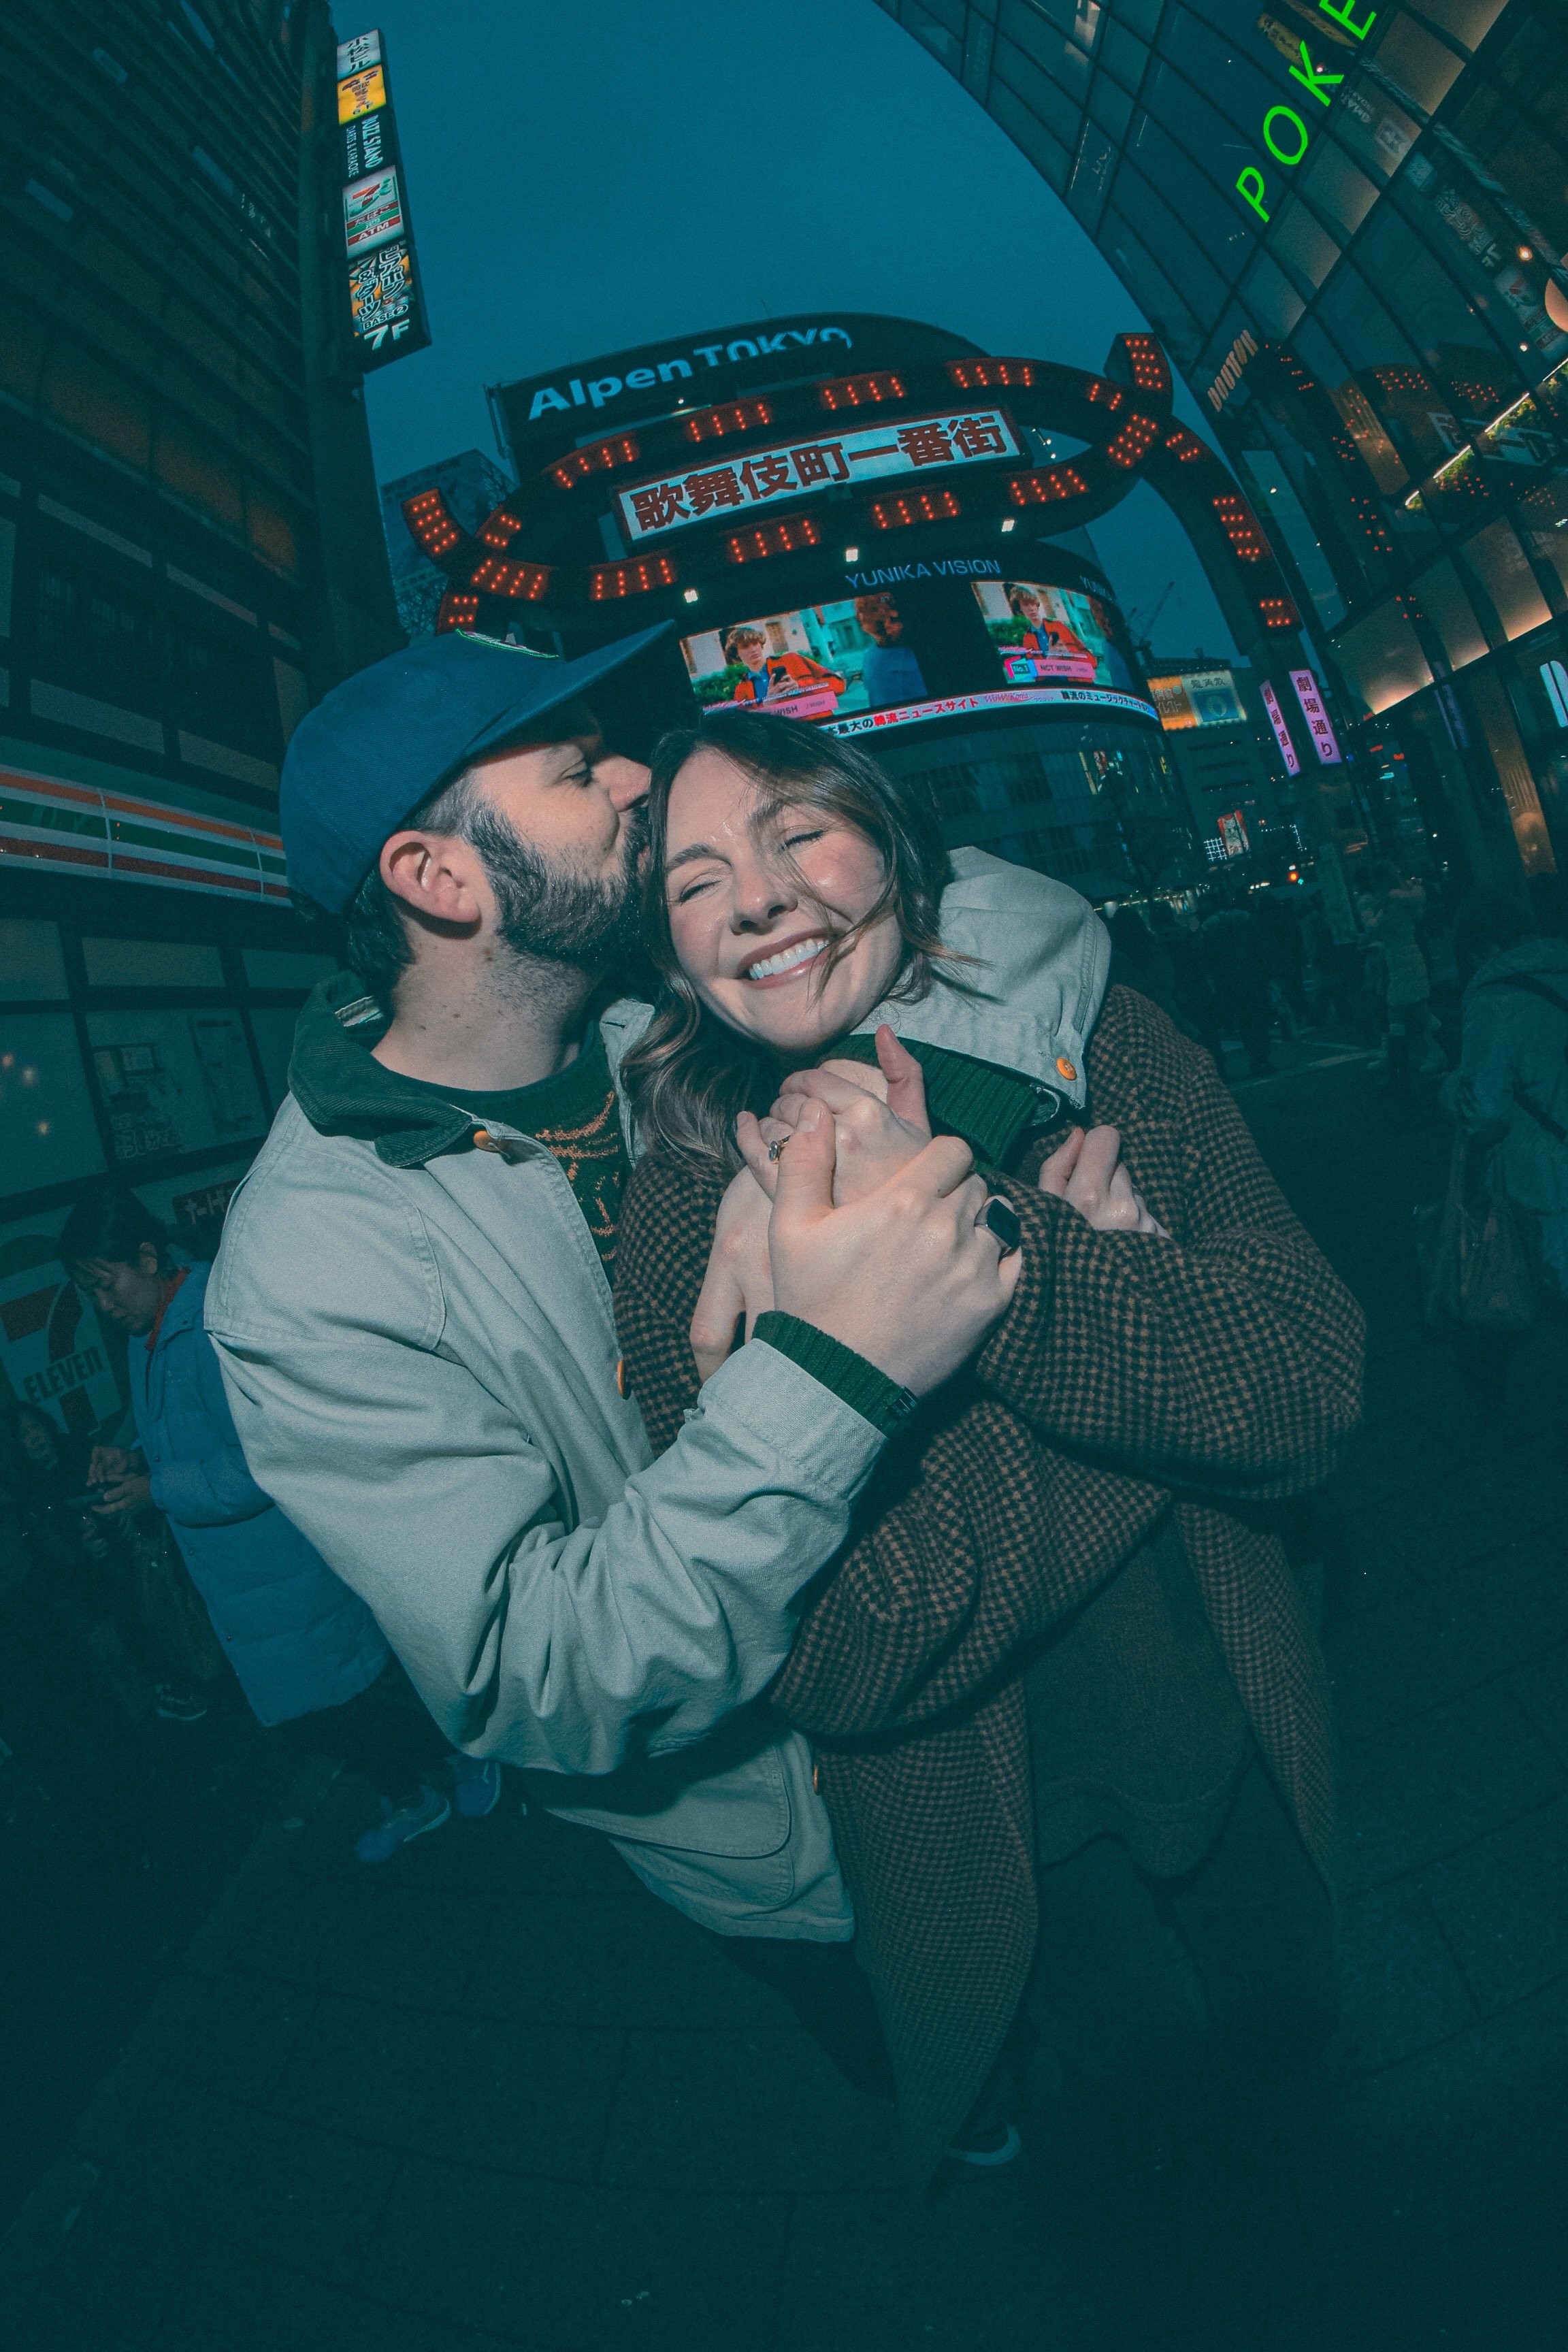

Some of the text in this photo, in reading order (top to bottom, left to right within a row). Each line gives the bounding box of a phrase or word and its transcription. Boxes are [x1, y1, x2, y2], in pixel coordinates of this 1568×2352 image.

[346, 125, 357, 148] DARTS
[362, 115, 383, 169] BUZZ STAND
[348, 151, 359, 178] KARAOKE
[359, 222, 389, 240] ATM
[364, 319, 409, 350] 7F
[529, 357, 693, 420] Alpen
[630, 416, 1008, 532] 歌舞伎町一番街
[845, 559, 1002, 589] YUNIKA VISION
[1296, 676, 1333, 758] 劇場通り
